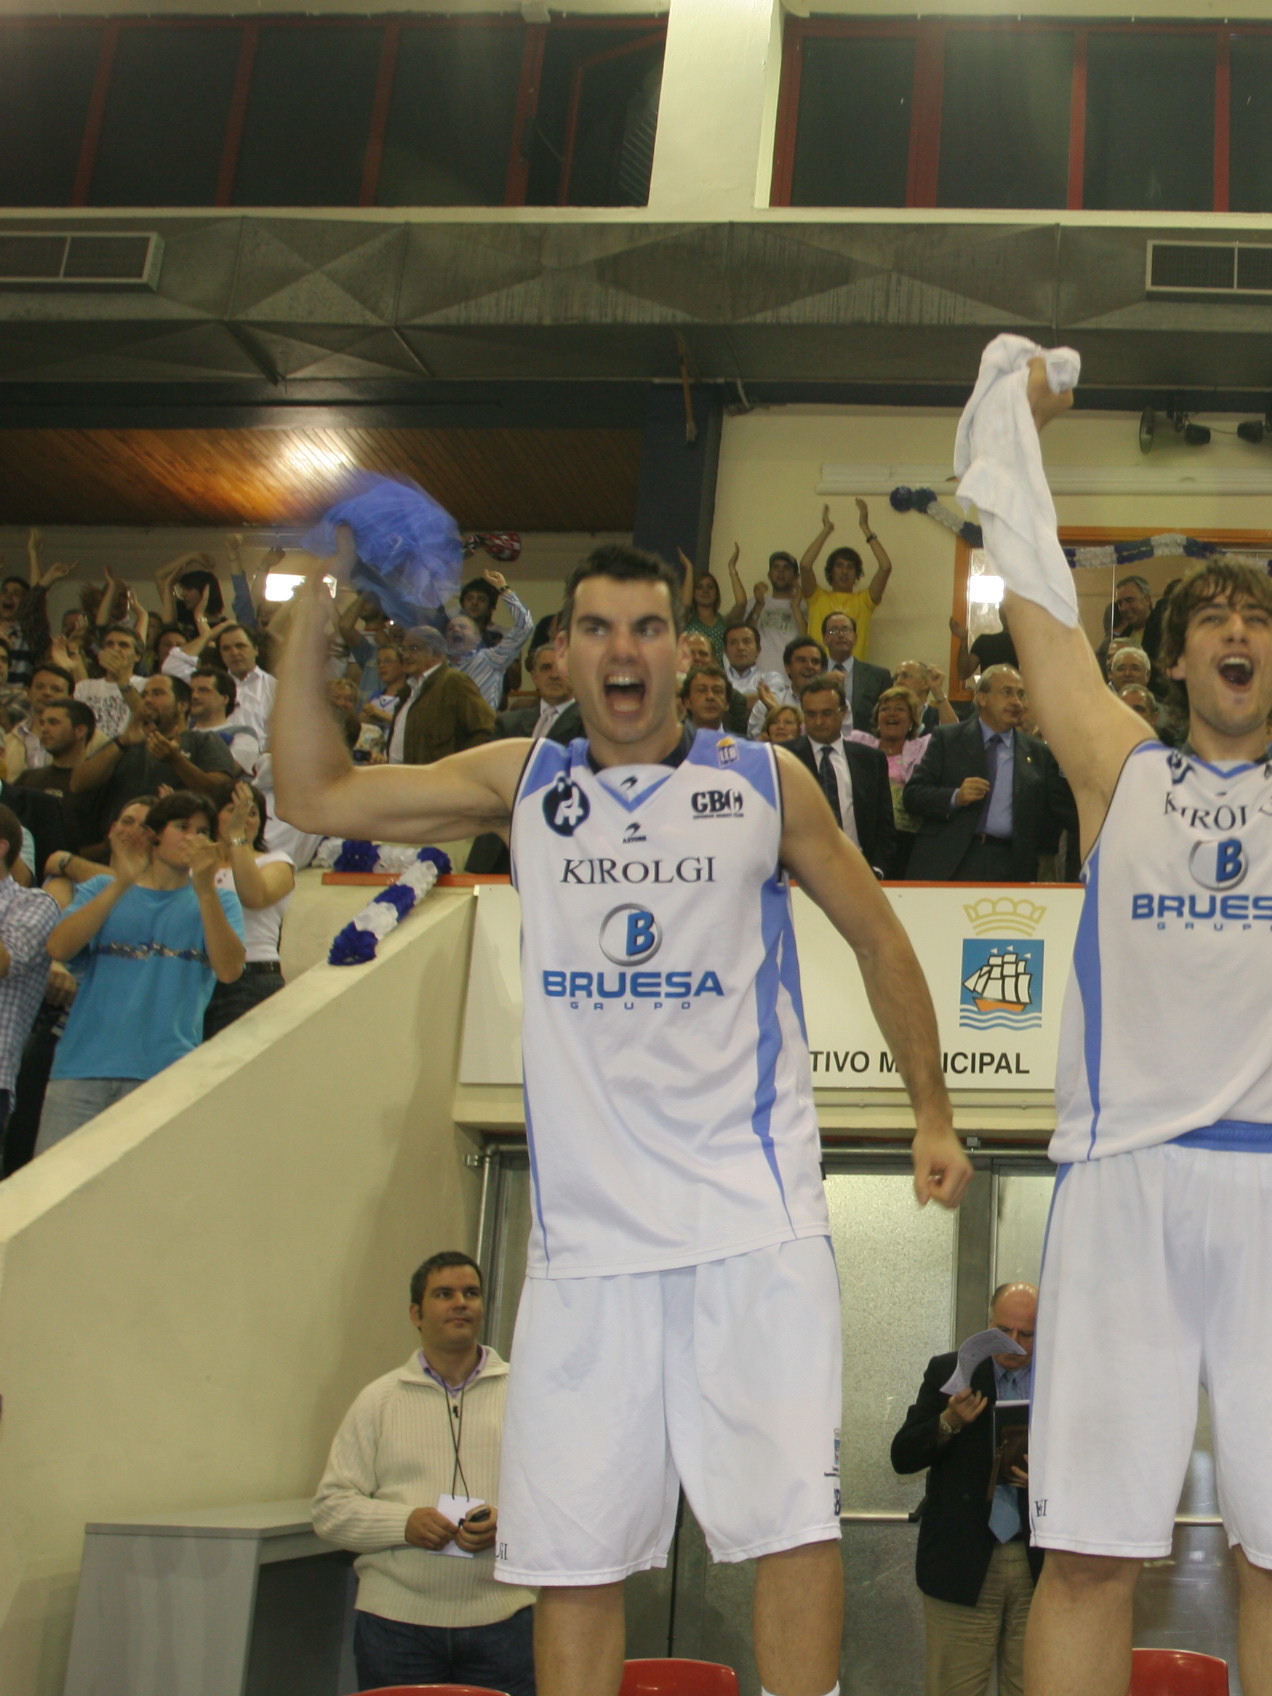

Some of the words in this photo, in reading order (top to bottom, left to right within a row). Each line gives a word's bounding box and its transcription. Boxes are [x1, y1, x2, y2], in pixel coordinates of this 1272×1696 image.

[560, 857, 716, 884] KIROLGI
[1216, 838, 1242, 883] B
[626, 911, 655, 956] B
[543, 970, 725, 998] BRUESA
[570, 1002, 691, 1010] GRUPO
[810, 1051, 870, 1073] TIVO
[880, 1052, 1030, 1074] MICIPAL
